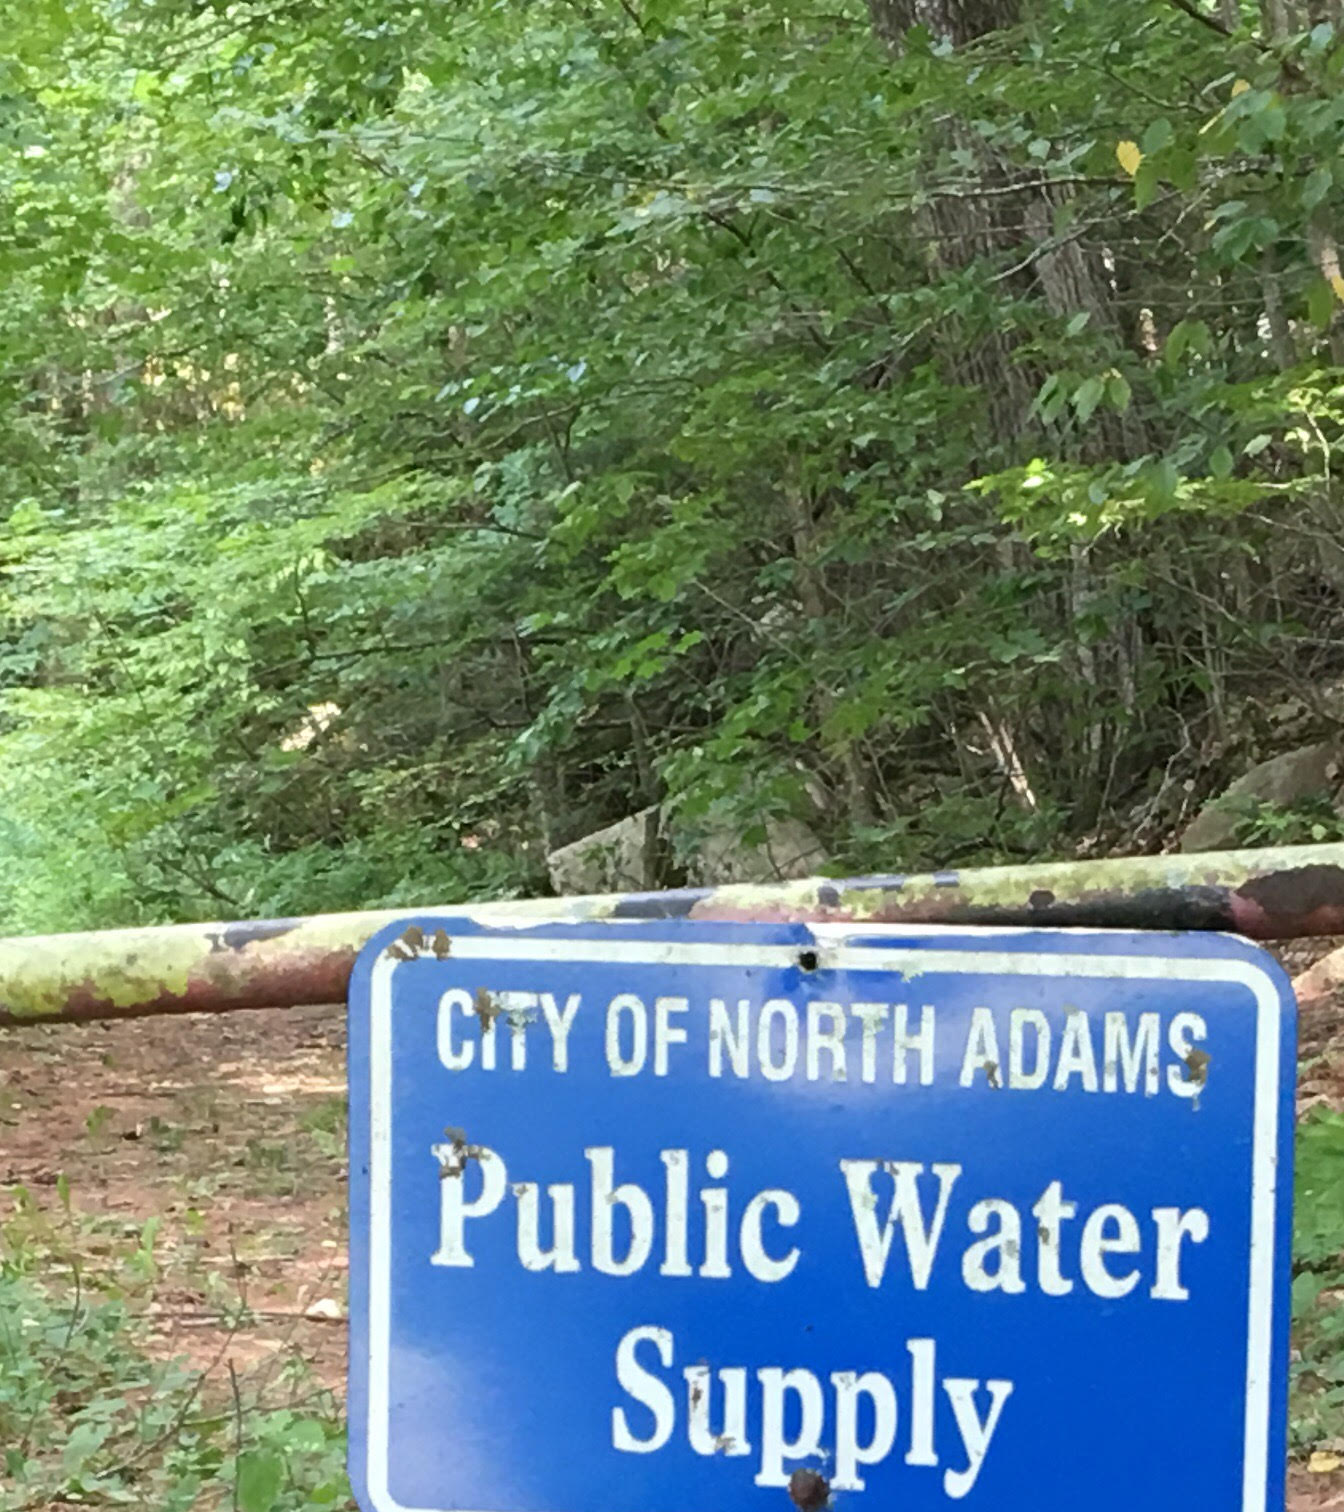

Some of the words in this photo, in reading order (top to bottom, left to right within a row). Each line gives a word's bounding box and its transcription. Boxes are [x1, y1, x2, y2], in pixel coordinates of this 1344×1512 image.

[435, 988, 581, 1074] CITY
[605, 993, 689, 1078] OF
[709, 998, 936, 1087] NORTH
[959, 1008, 1209, 1100] ADAMS
[430, 1143, 801, 1282] Public
[839, 1158, 1209, 1302] Water
[611, 1325, 1014, 1500] Supply
